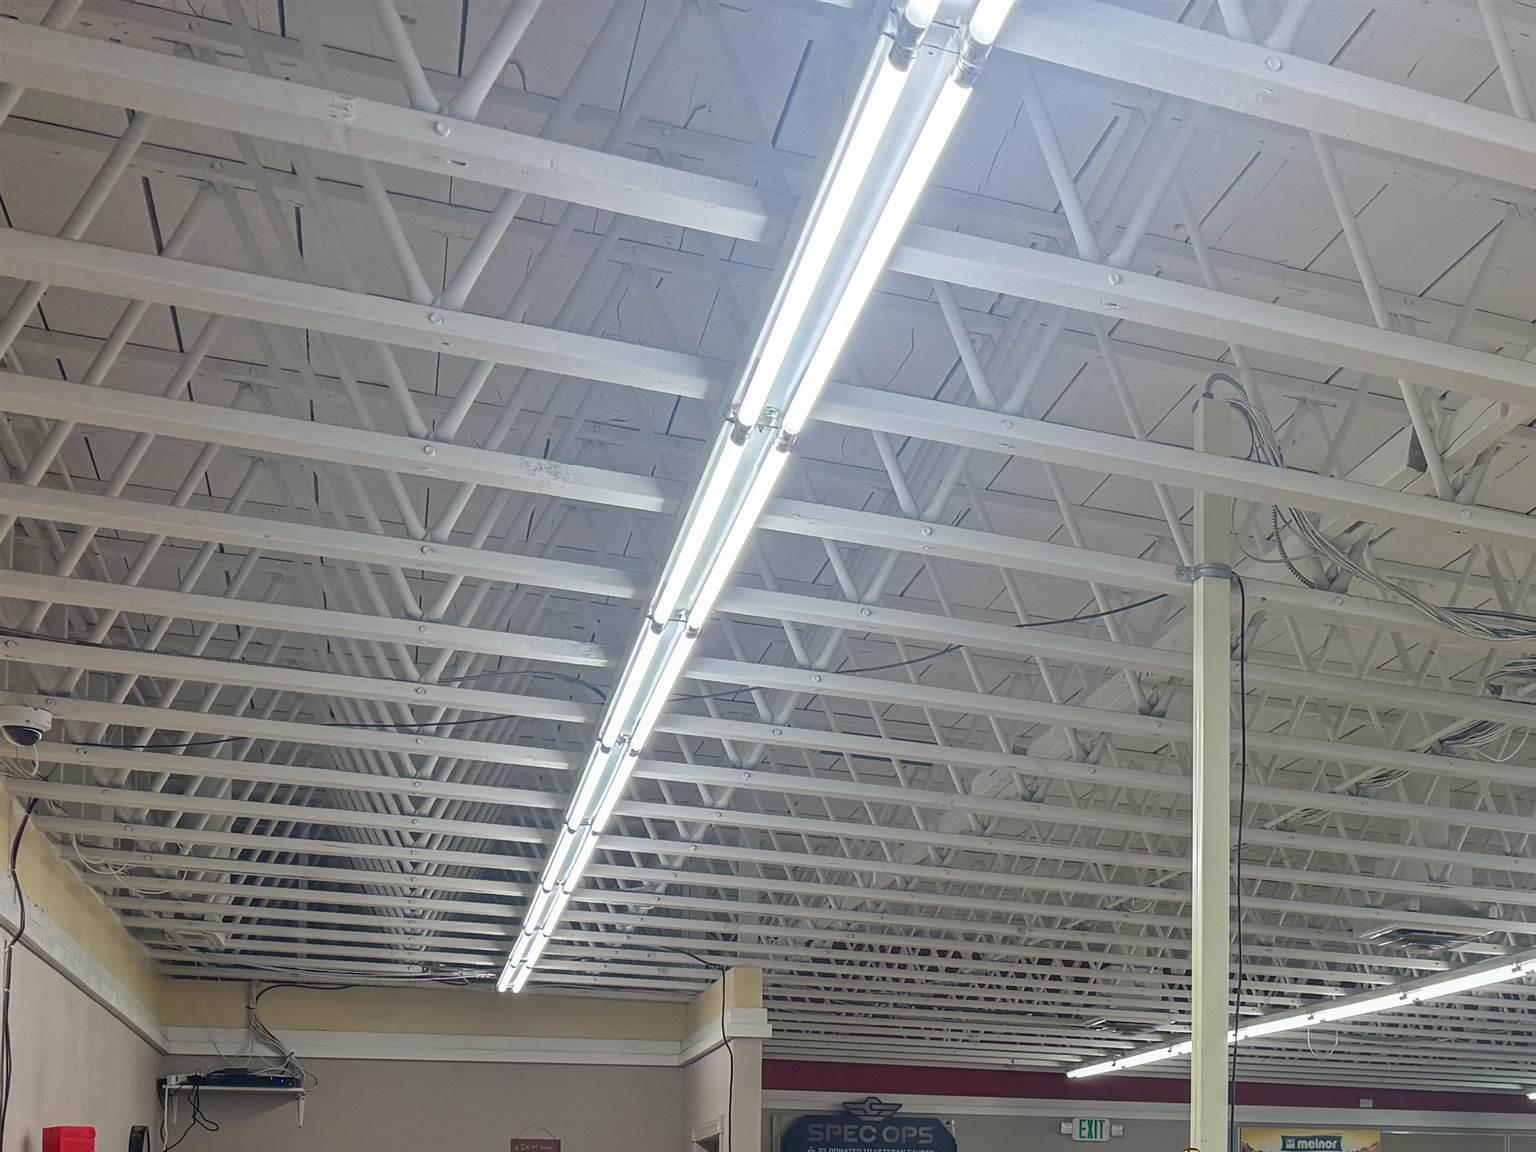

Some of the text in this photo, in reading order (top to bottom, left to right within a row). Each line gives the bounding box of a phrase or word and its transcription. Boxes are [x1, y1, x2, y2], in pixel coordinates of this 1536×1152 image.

[807, 1123, 934, 1144] SPEC OPS
[1079, 1119, 1106, 1139] EXIT
[1297, 1137, 1338, 1150] melnor
